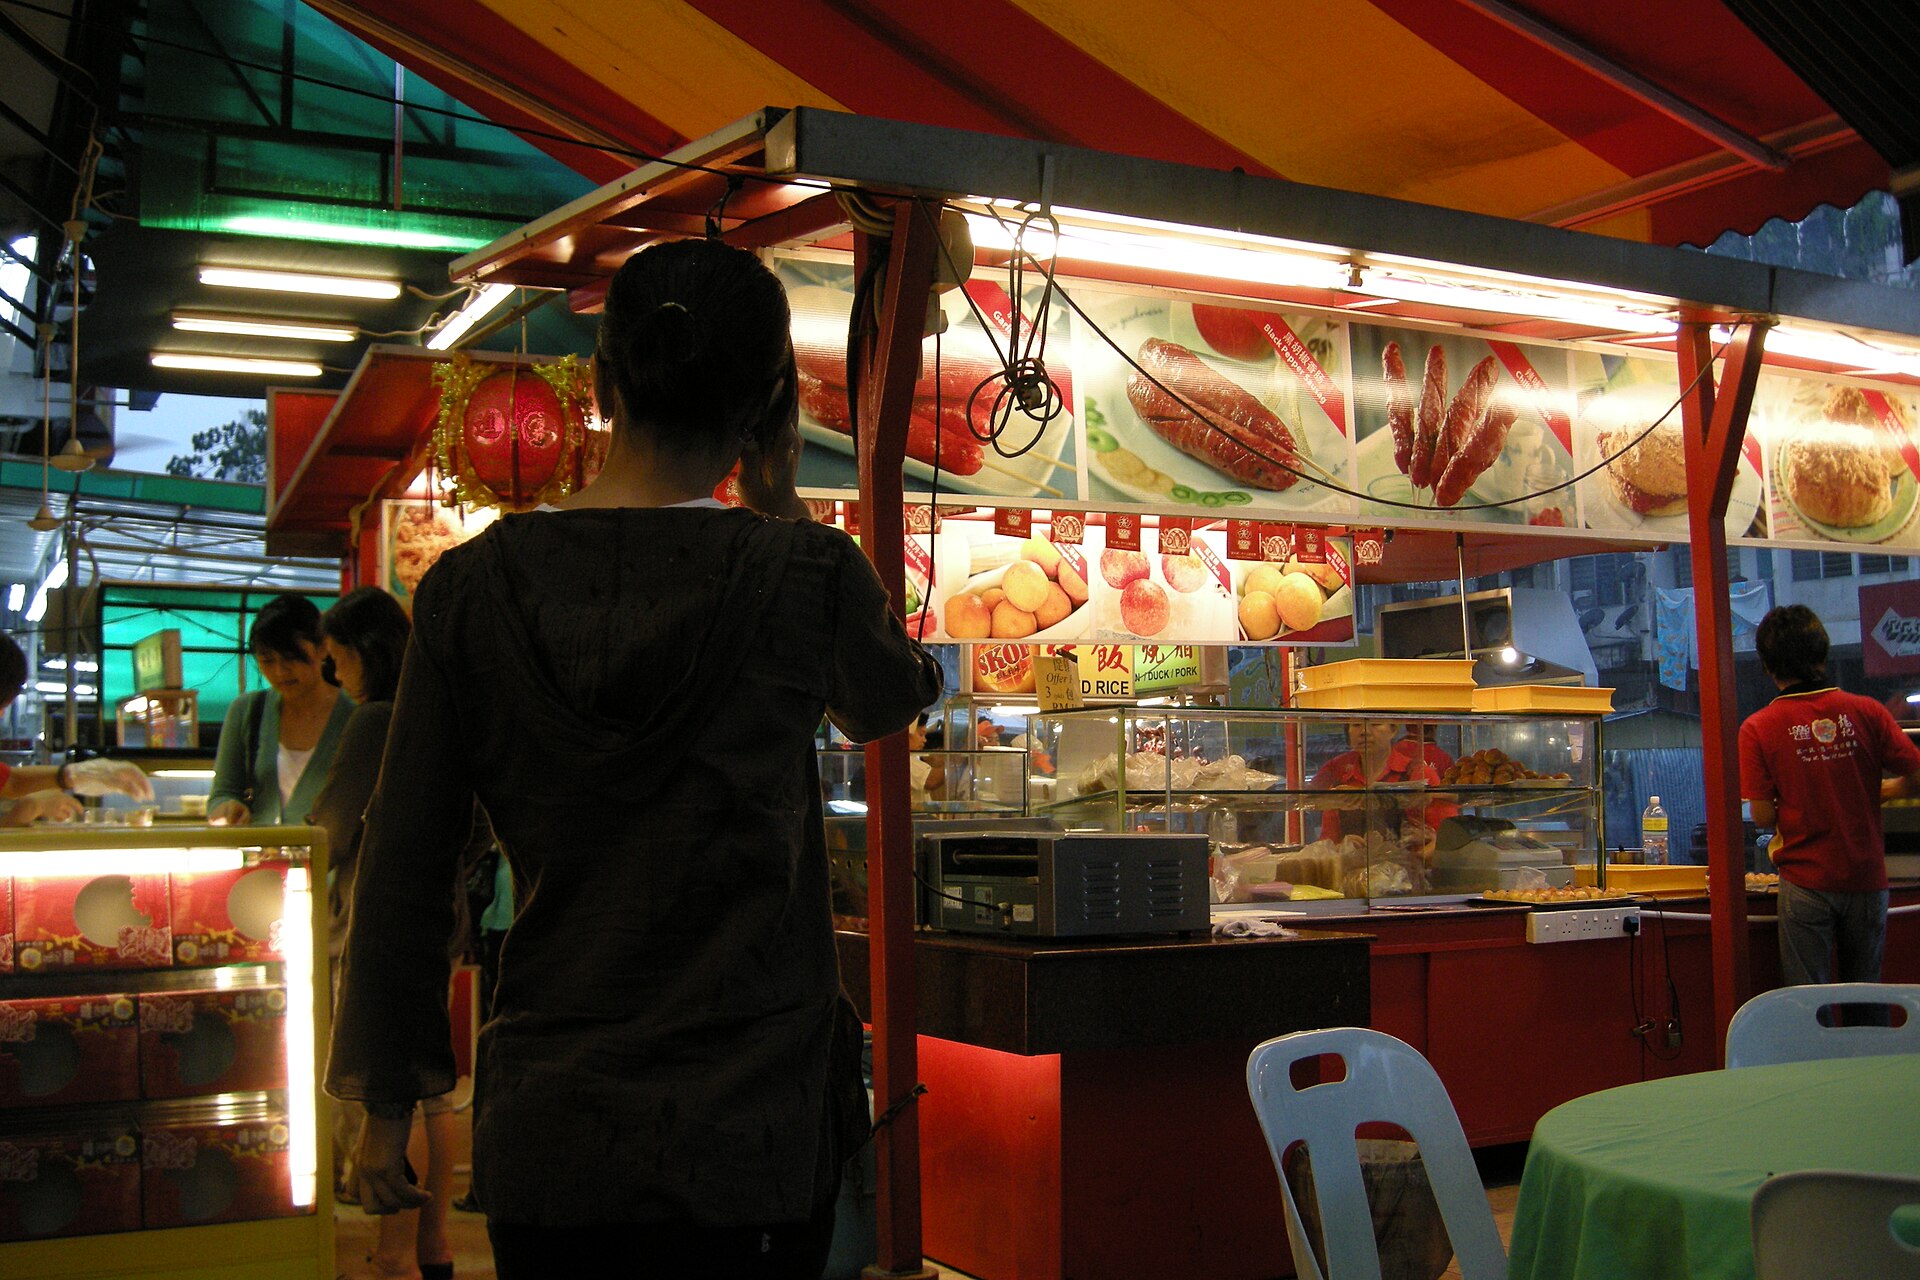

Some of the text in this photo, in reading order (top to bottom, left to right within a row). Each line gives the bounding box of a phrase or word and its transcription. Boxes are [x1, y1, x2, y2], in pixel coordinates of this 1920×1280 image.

[1263, 323, 1282, 347] Black
[1281, 345, 1305, 375] Pepper
[1046, 672, 1067, 685] Offer
[1148, 670, 1170, 681] DUCK
[1175, 666, 1197, 677] PORK
[1096, 680, 1130, 695] RICE
